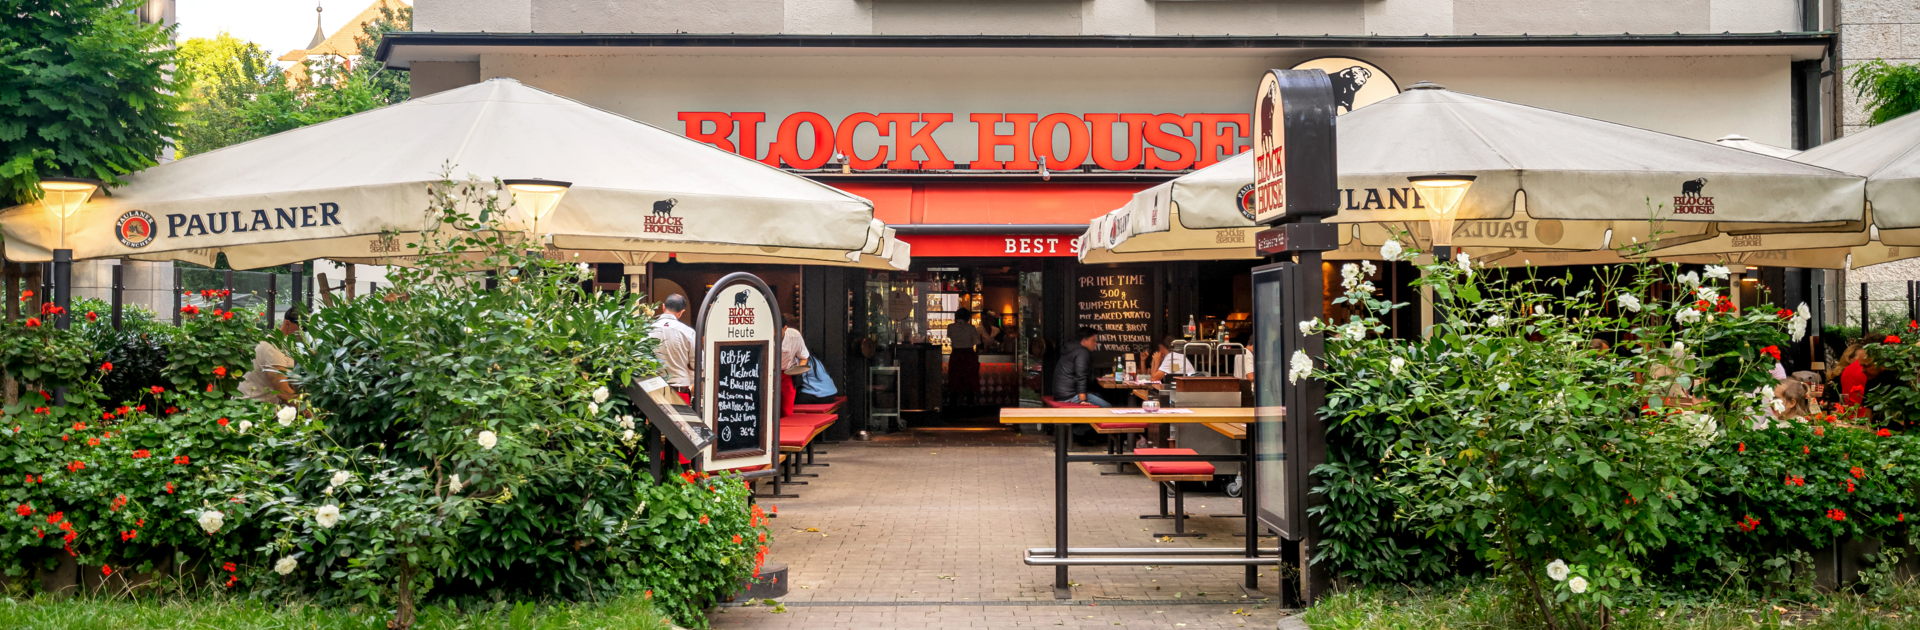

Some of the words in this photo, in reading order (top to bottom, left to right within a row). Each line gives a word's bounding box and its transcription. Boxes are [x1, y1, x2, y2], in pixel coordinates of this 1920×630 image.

[678, 111, 954, 170] BLOCK
[969, 112, 1250, 170] HOUSE
[1257, 145, 1283, 185] BLOCK
[1237, 184, 1255, 199] PAUL
[1257, 178, 1284, 214] HOUSE
[1673, 196, 1715, 206] BLOCK
[1673, 205, 1715, 214] HOUSE
[116, 210, 154, 227] PAULANER
[165, 202, 342, 239] PAULANER
[643, 215, 684, 226] BLOCK
[643, 224, 684, 234] HOUSE
[1004, 238, 1059, 254] BEST
[1078, 276, 1115, 288] PRIME
[1117, 274, 1146, 286] TIME
[1100, 288, 1120, 298] 300
[1078, 299, 1140, 310] RUMPSTEAK
[728, 308, 754, 316] BLOCK
[1094, 312, 1122, 320] BAKED
[728, 317, 754, 325] HOUSE
[728, 327, 754, 338] Heute
[1105, 324, 1124, 332] HOUSE
[1126, 323, 1148, 331] BROT
